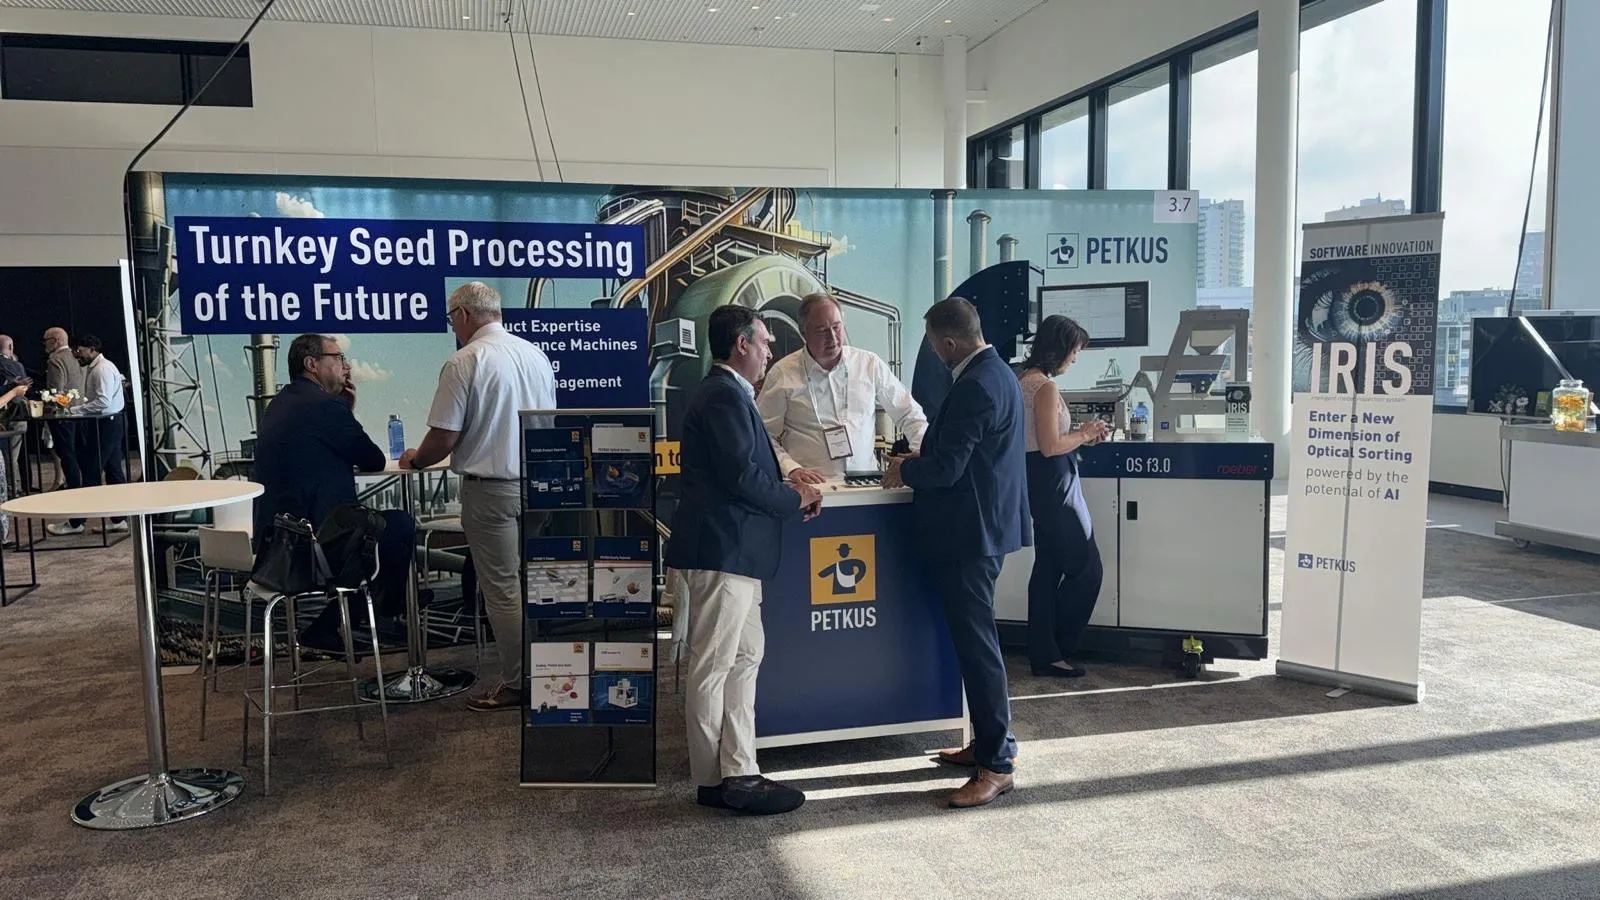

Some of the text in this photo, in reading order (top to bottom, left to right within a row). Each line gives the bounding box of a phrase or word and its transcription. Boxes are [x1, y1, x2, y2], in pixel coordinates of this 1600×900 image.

[1168, 197, 1192, 213] 3.7
[189, 225, 634, 277] Turnkey Seed Processing
[1086, 236, 1169, 265] PETKUS
[1310, 240, 1434, 260] SOFTWARE INNOVATION
[194, 283, 429, 321] of the Future
[503, 320, 601, 335] uct Expertise
[570, 339, 638, 351] Machines
[1310, 342, 1413, 396] IRIS
[554, 376, 622, 391] nagement
[1227, 402, 1248, 414] IRIS
[1309, 410, 1394, 425] Enter a New
[1308, 427, 1401, 443] Dimension of
[1307, 445, 1413, 464] Optical Sorting
[1126, 457, 1171, 472] OS f3.0
[1306, 467, 1409, 484] powered by the
[1305, 484, 1400, 500] potential of AI
[1316, 557, 1356, 573] PETKUS
[810, 606, 878, 632] PETKUS
